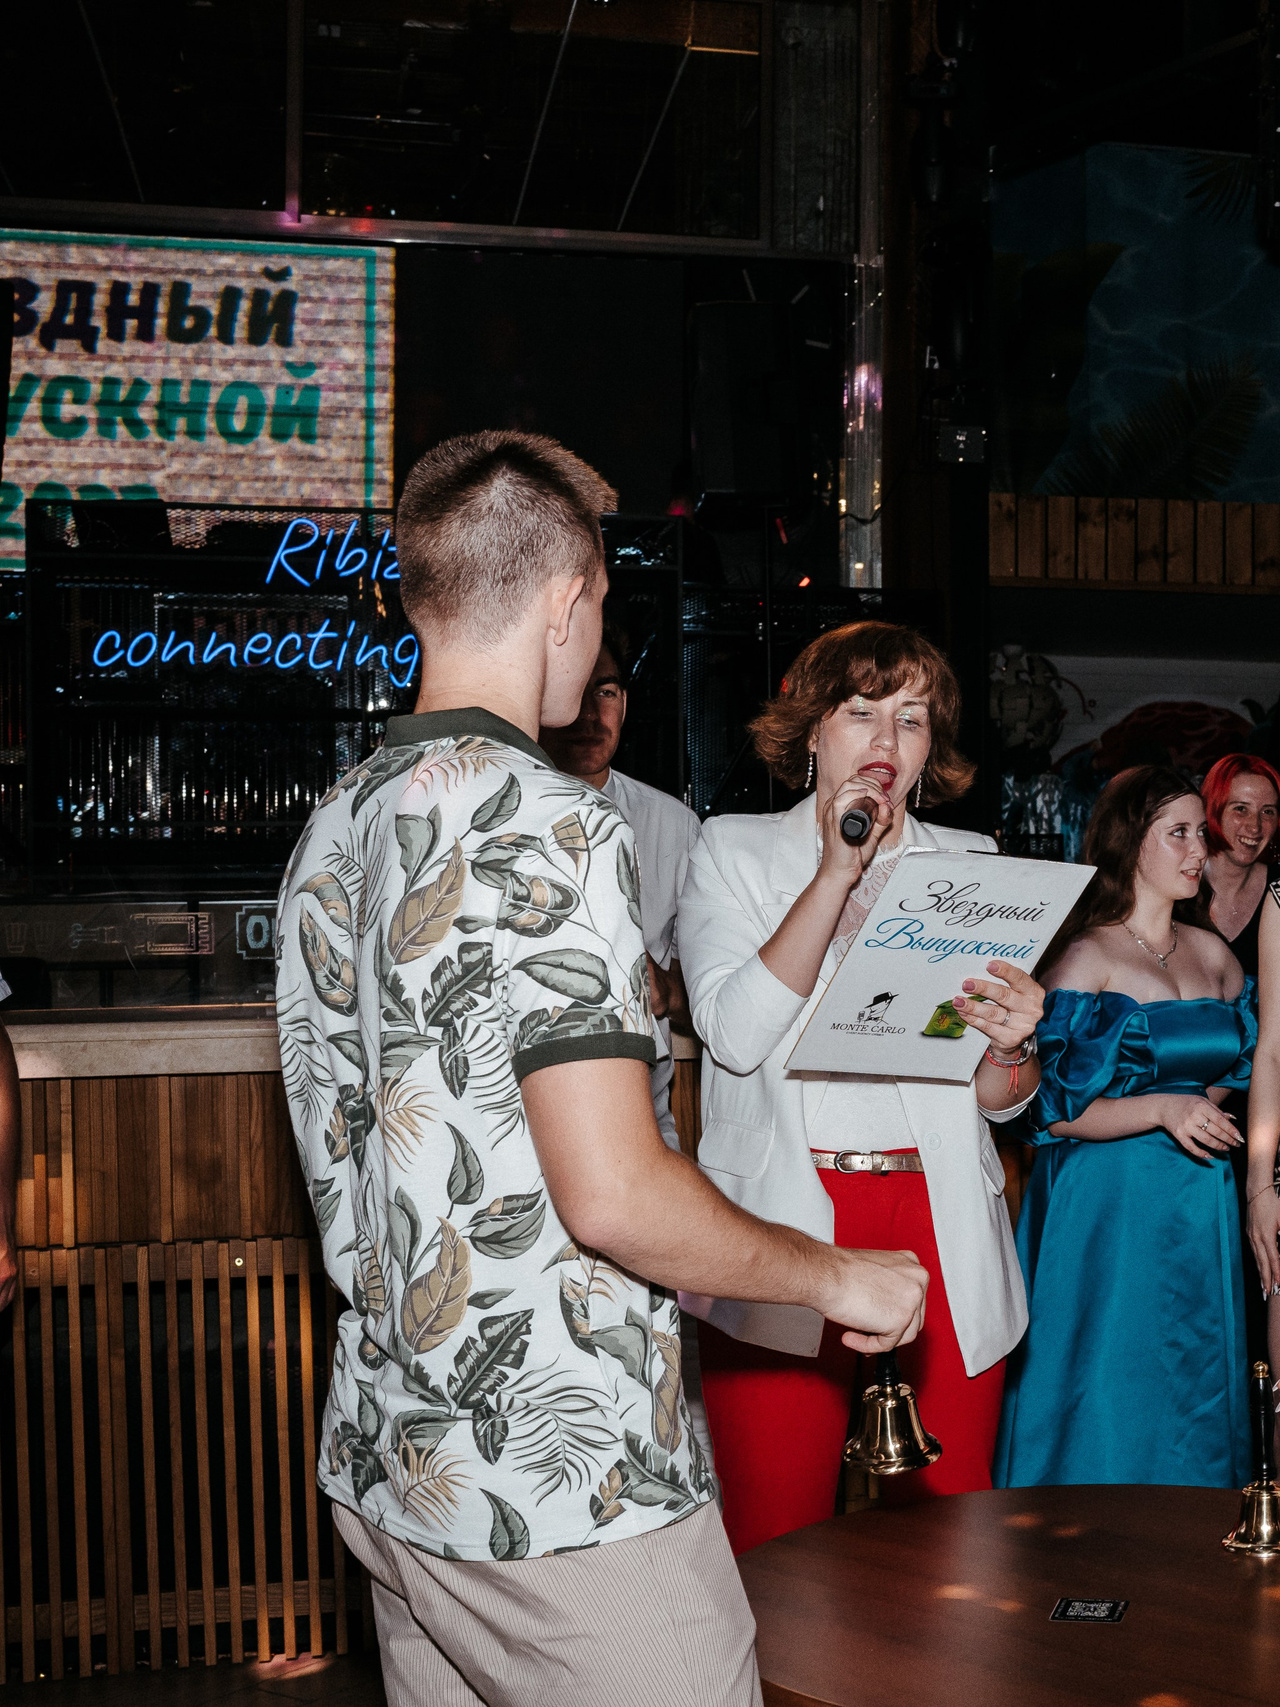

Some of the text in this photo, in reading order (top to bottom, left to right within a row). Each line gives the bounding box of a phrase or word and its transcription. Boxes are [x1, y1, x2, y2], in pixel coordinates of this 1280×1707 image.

[92, 618, 419, 688] connecting
[898, 879, 1051, 928] Звездный
[864, 917, 1040, 963] Выпускной
[830, 1022, 869, 1032] MONTE
[870, 1025, 906, 1035] CARLO
